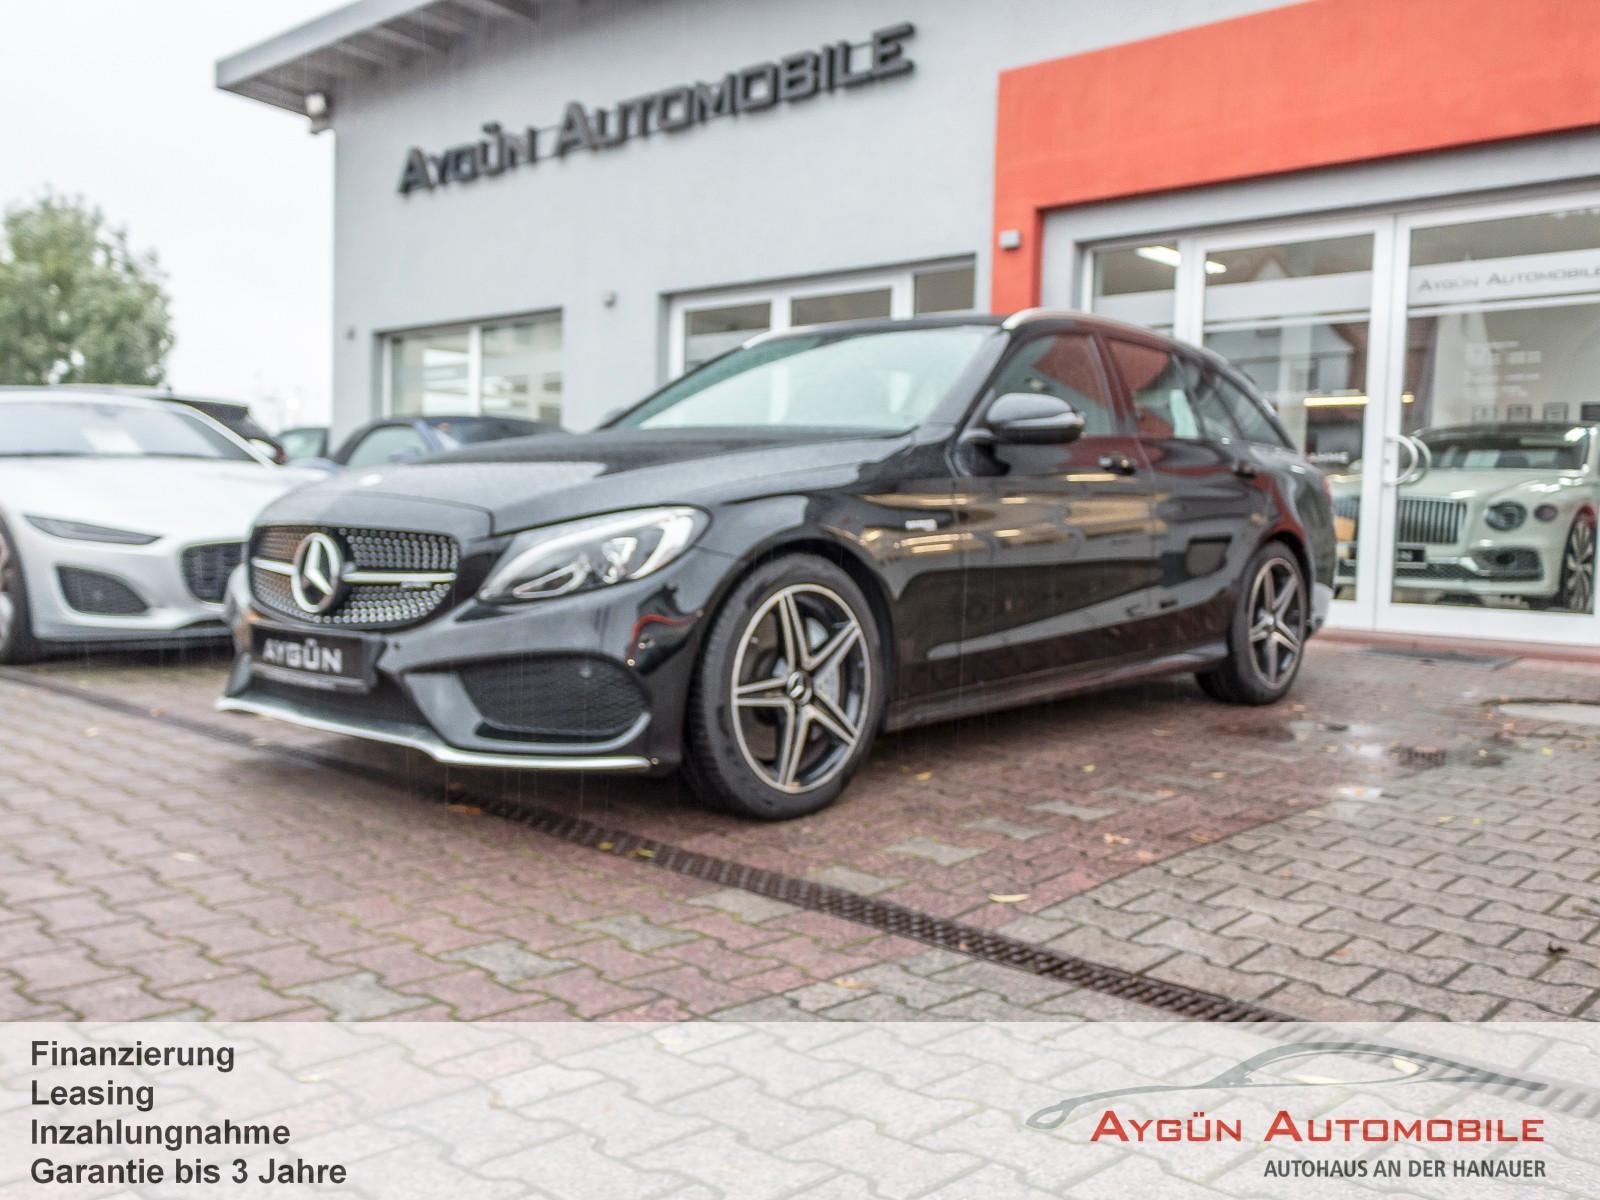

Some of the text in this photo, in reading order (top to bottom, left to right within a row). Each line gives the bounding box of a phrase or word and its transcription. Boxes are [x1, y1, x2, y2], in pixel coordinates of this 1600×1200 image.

[397, 21, 916, 193] AYGÜN AUTOMOBILE
[262, 637, 343, 674] AYGÜN
